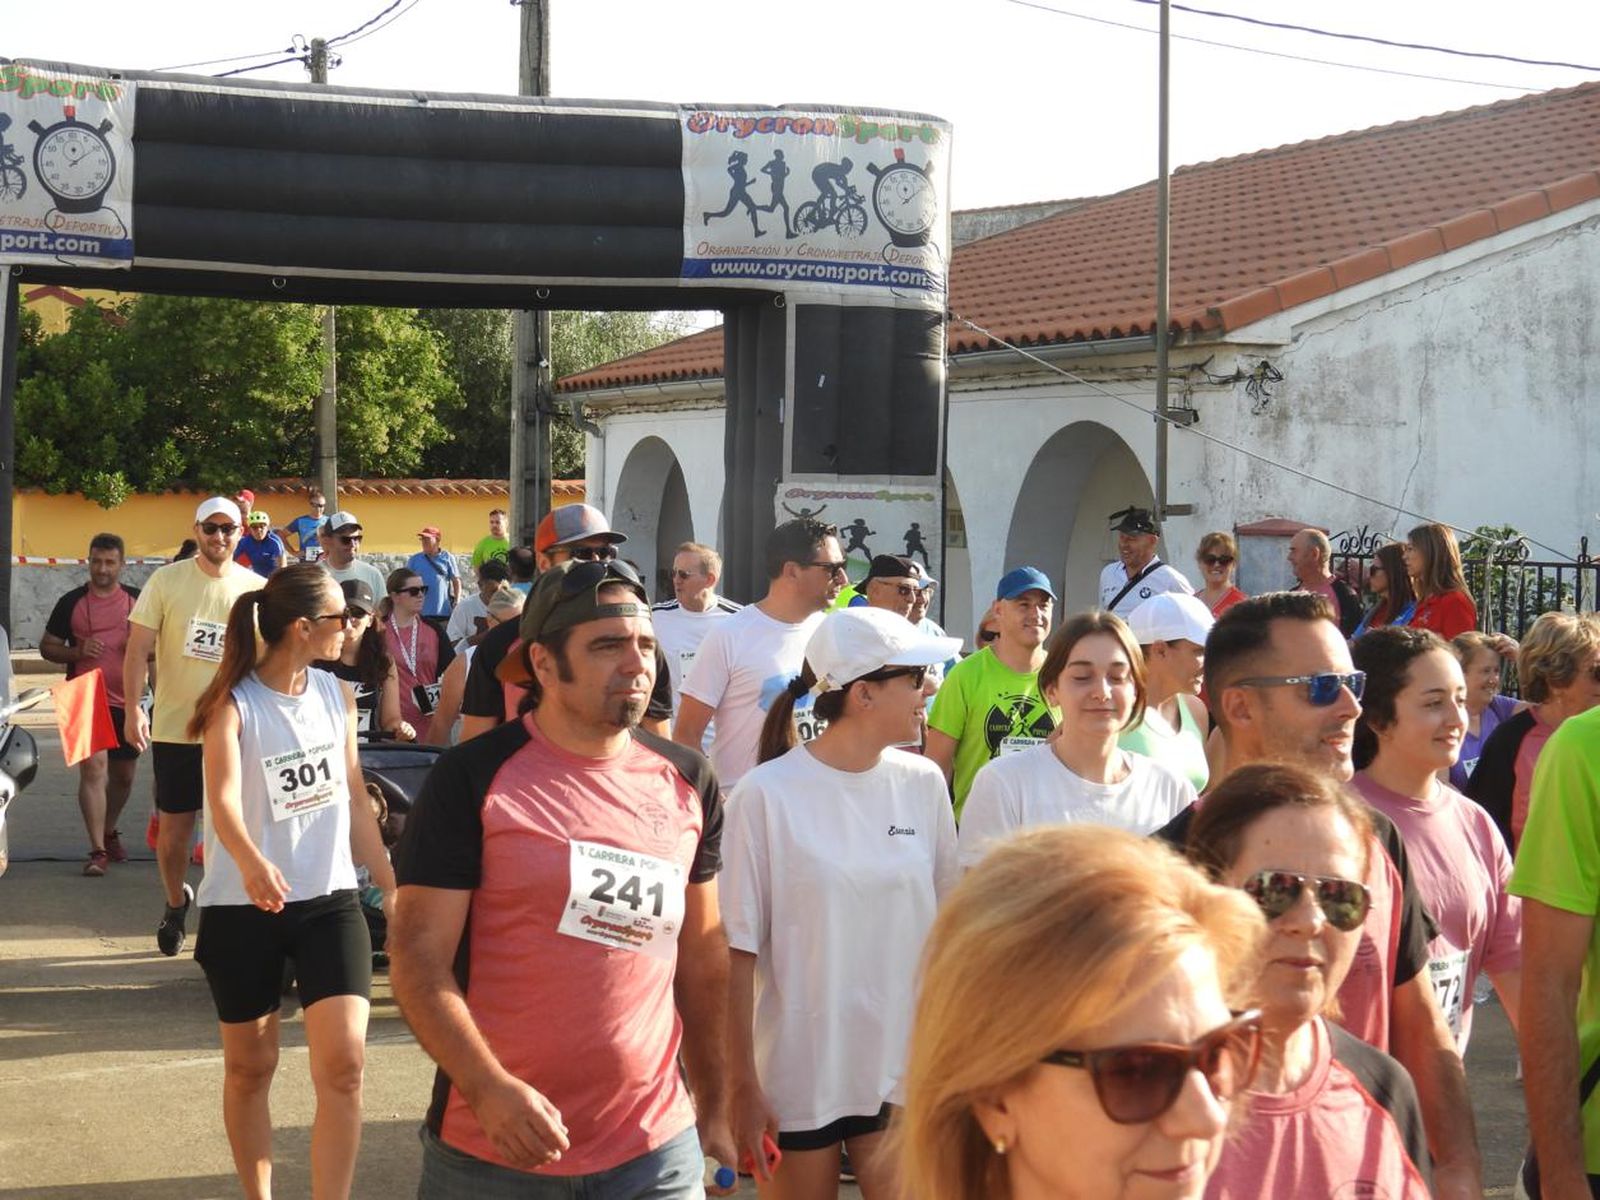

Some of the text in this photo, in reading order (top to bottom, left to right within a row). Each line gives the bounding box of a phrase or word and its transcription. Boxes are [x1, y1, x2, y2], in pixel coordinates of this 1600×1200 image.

[711, 262, 928, 287] www.orycronsport.com
[279, 757, 331, 793] 301
[588, 847, 636, 867] CARRERA
[589, 868, 664, 918] 241
